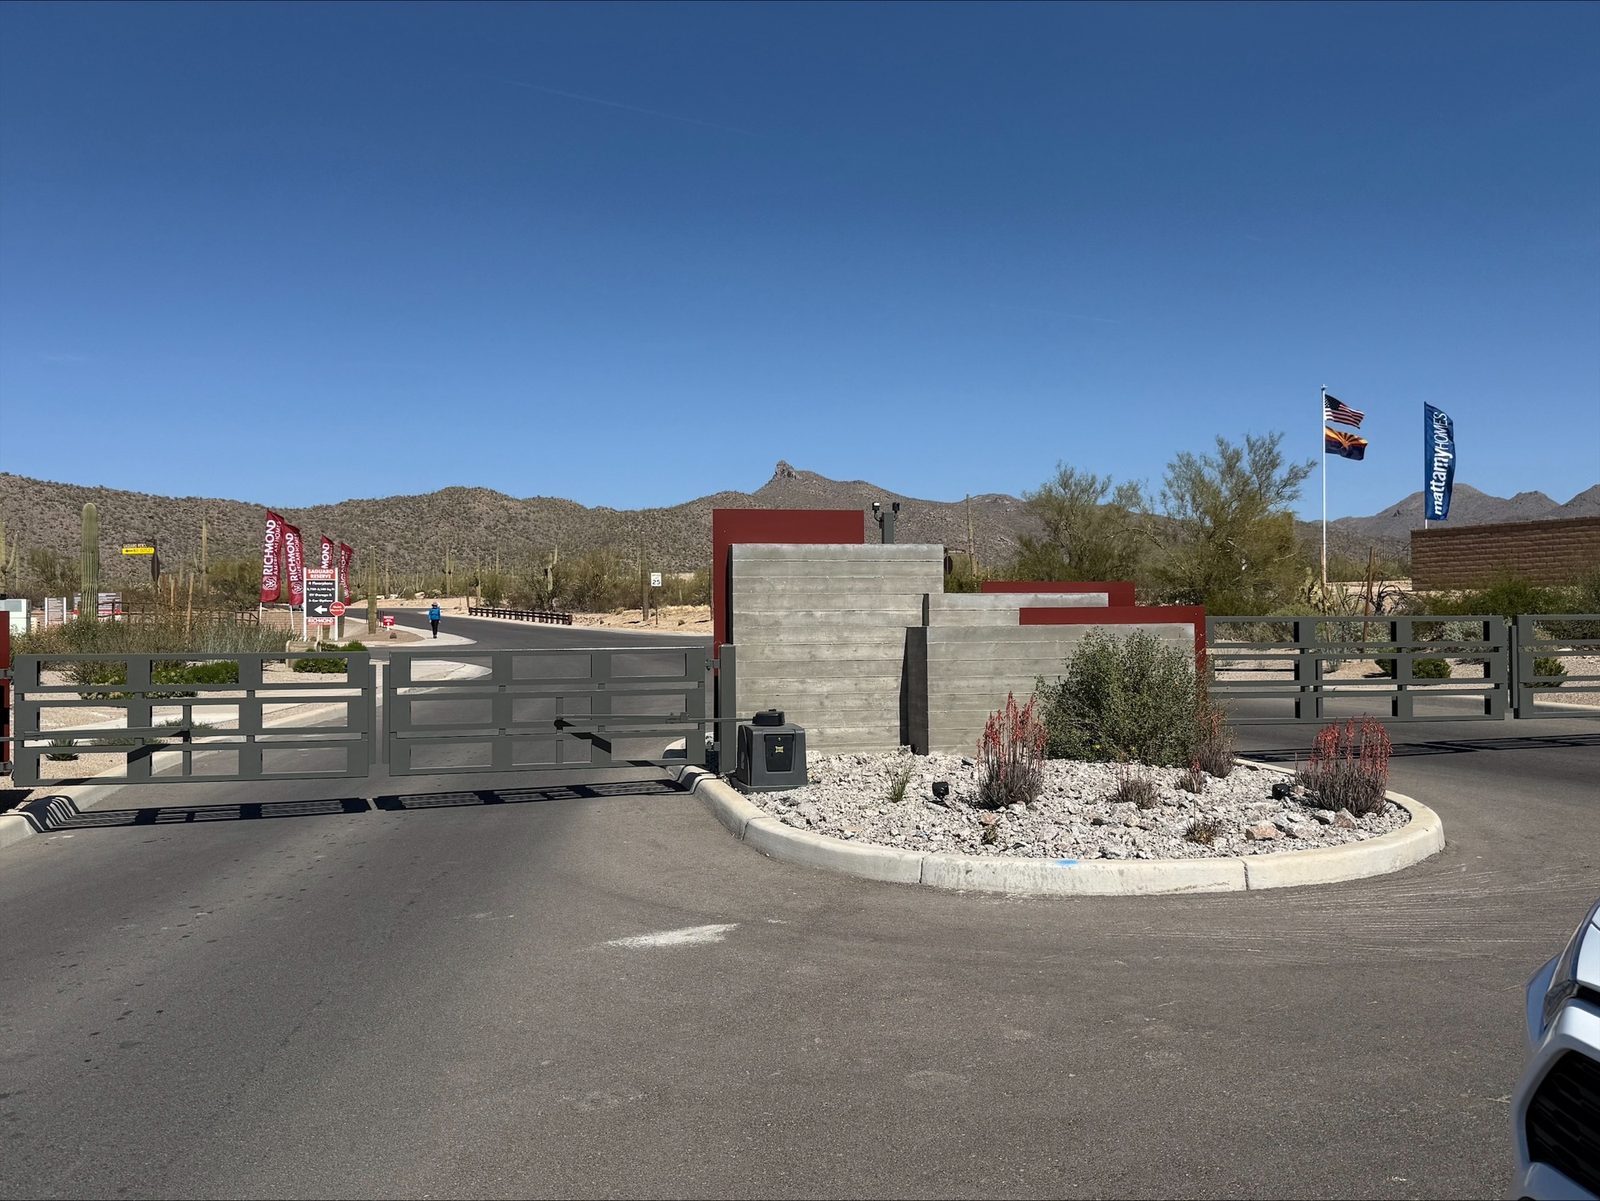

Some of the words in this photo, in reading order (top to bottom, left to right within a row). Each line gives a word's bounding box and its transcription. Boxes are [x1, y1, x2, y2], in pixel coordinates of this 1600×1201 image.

[1430, 411, 1453, 515] mattamyHOMES
[263, 519, 276, 576] RICHMOND
[285, 532, 299, 582] RICHMOND
